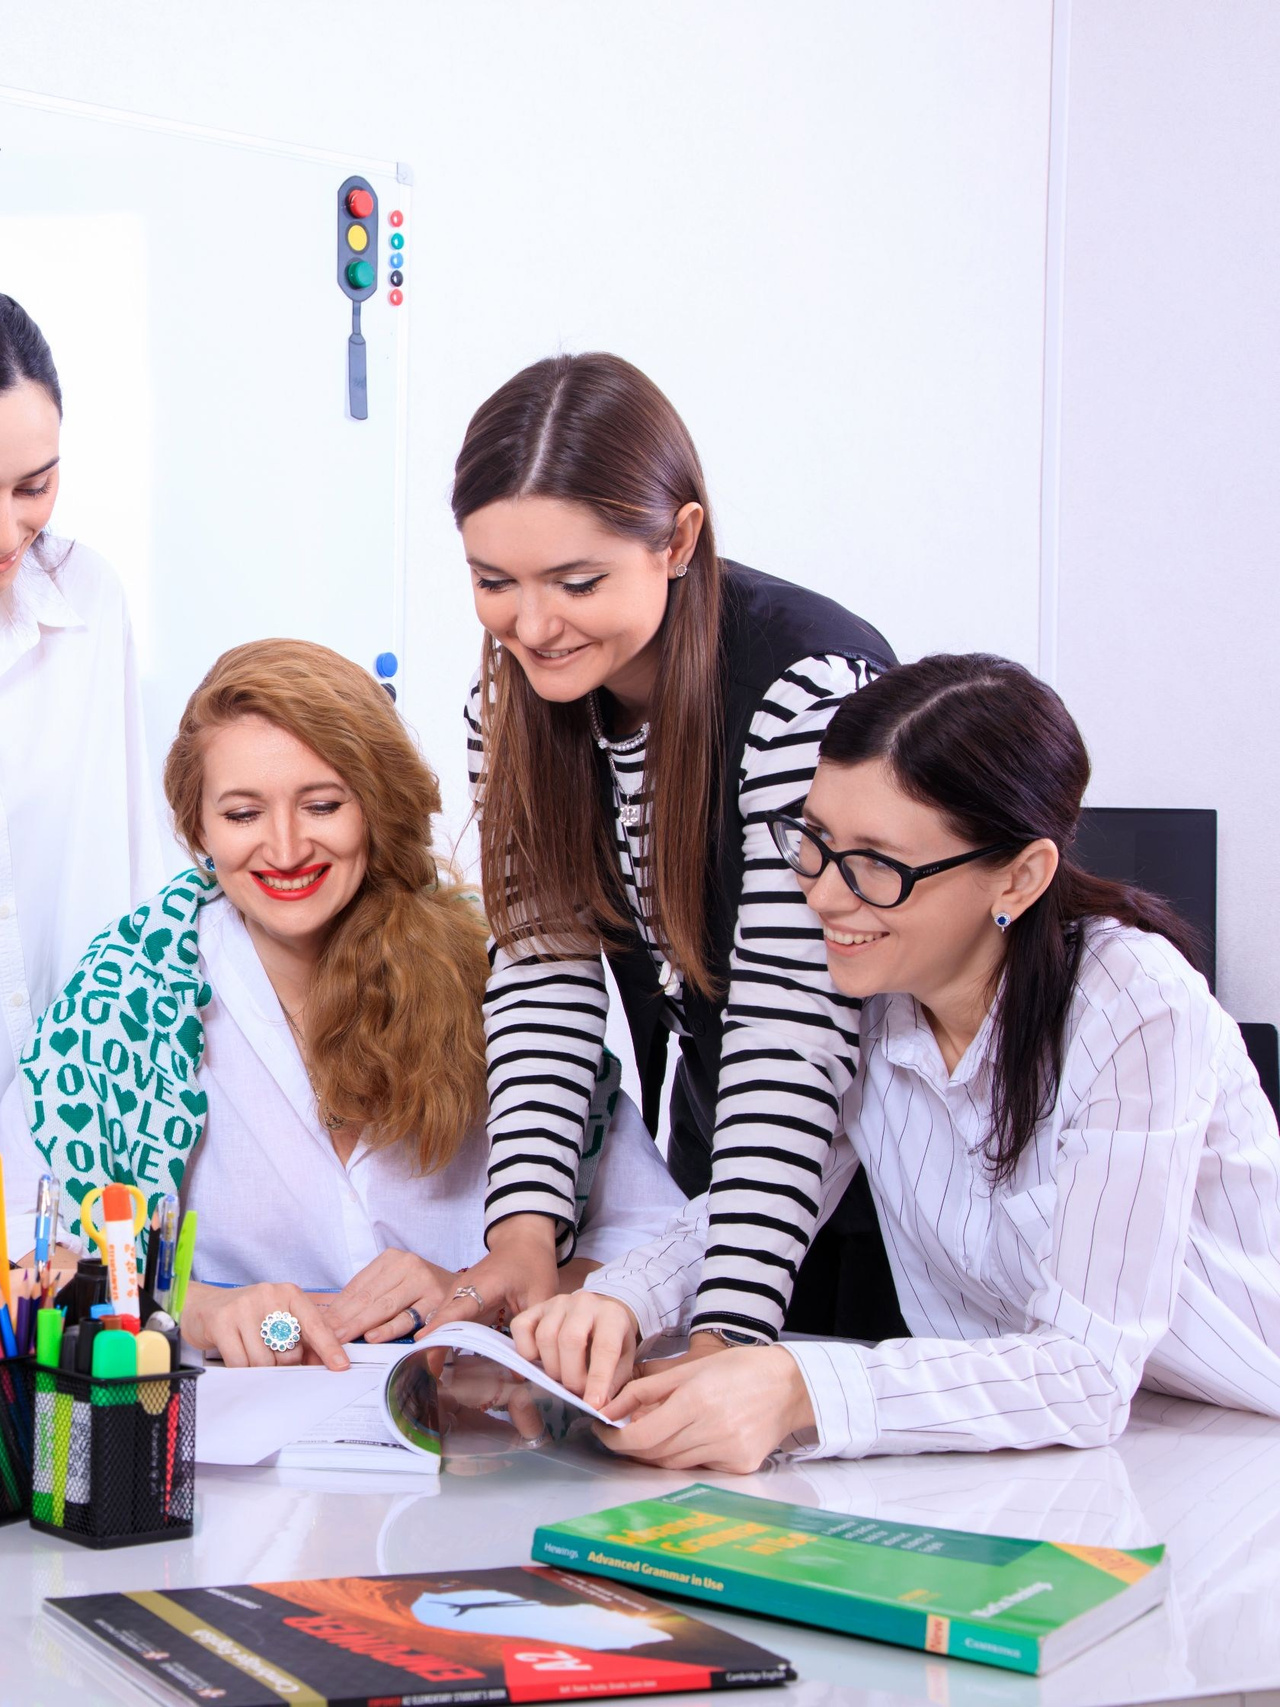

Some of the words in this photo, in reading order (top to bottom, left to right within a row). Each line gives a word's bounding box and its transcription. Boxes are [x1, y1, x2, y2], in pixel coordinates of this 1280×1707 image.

[543, 1542, 580, 1560] Hewings
[587, 1551, 641, 1573] Advanced
[640, 1563, 690, 1585] Grammar
[690, 1573, 703, 1587] in
[703, 1577, 725, 1592] Use
[282, 1615, 486, 1682] EMPOWER
[513, 1649, 593, 1672] A2
[725, 1671, 761, 1684] Cambridge
[761, 1669, 787, 1682] English
